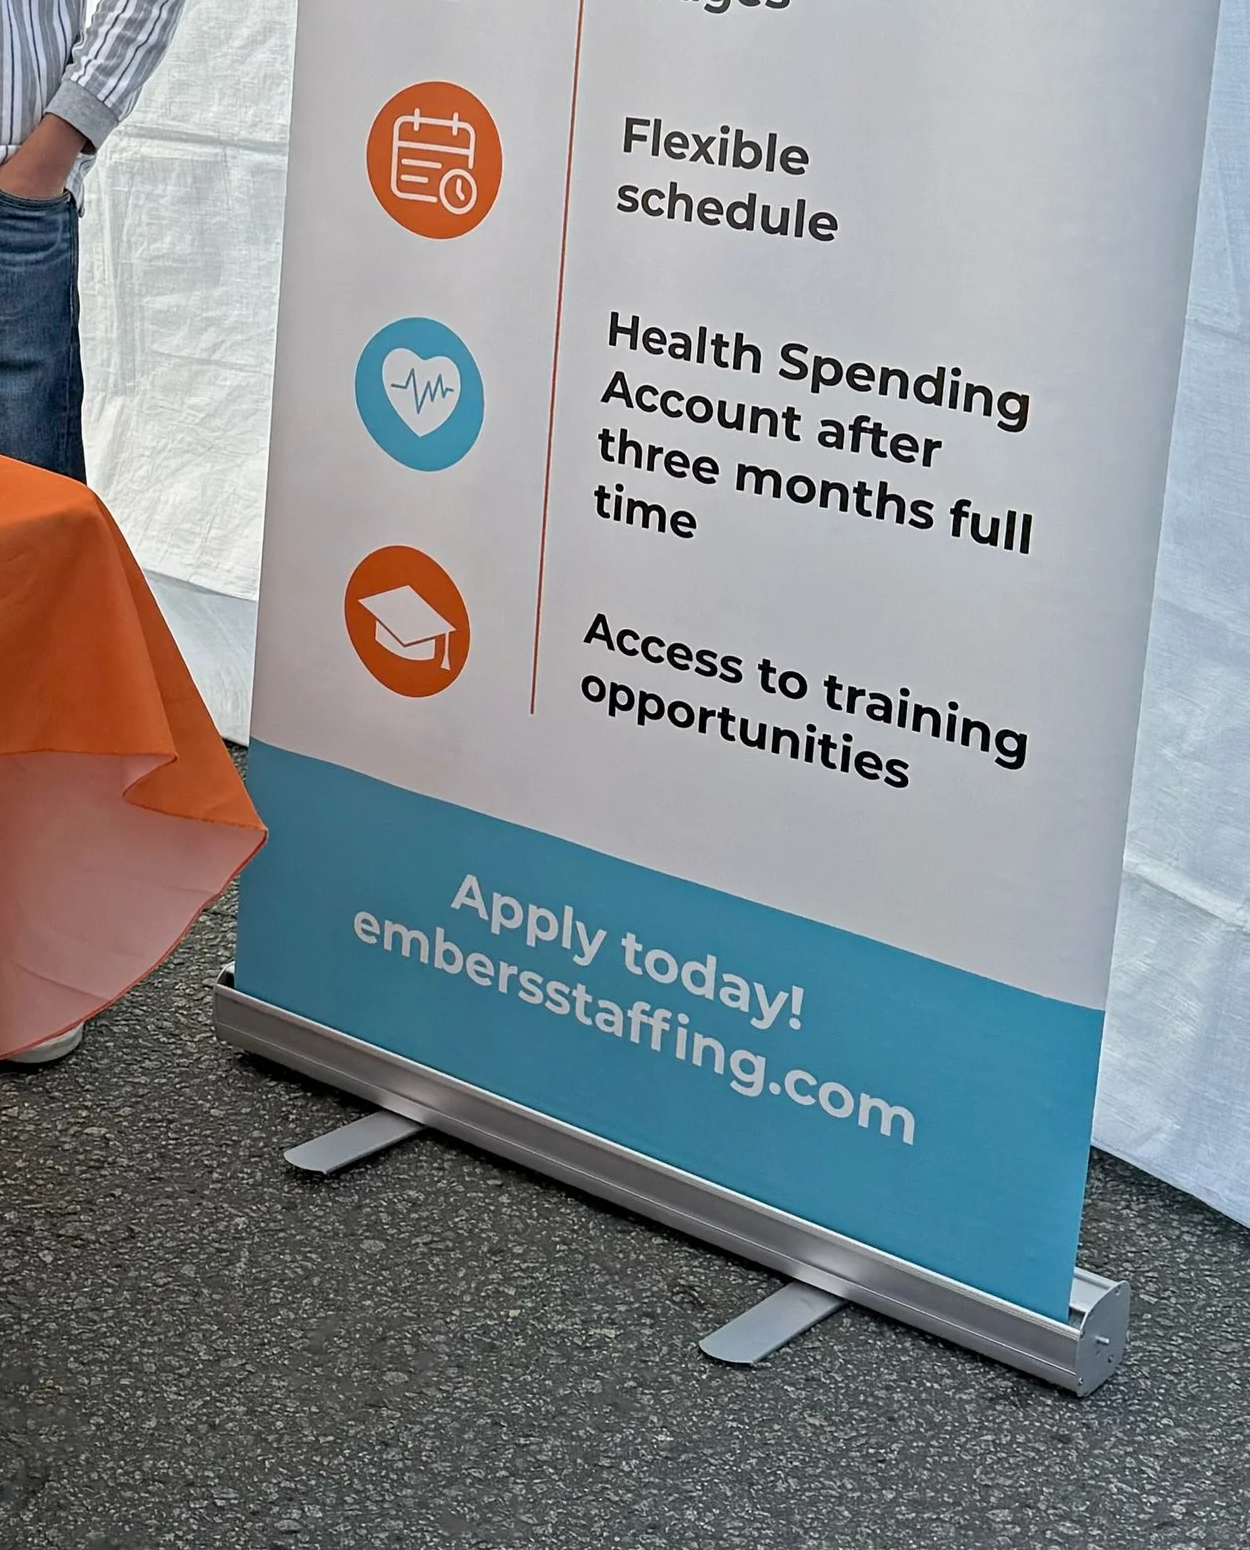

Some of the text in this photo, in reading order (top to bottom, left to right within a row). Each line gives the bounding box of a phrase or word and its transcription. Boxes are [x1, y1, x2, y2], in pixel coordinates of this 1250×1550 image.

[624, 118, 809, 175] Flexible
[617, 182, 837, 241] schedule
[601, 371, 942, 467] Account after
[609, 312, 1029, 432] Health Spending
[594, 485, 696, 538] time
[598, 429, 1032, 554] three months full
[582, 676, 909, 788] opportunities
[584, 614, 1027, 769] Access to training
[451, 875, 803, 1029] Apply today!
[355, 912, 914, 1143] embersstaffing.com
